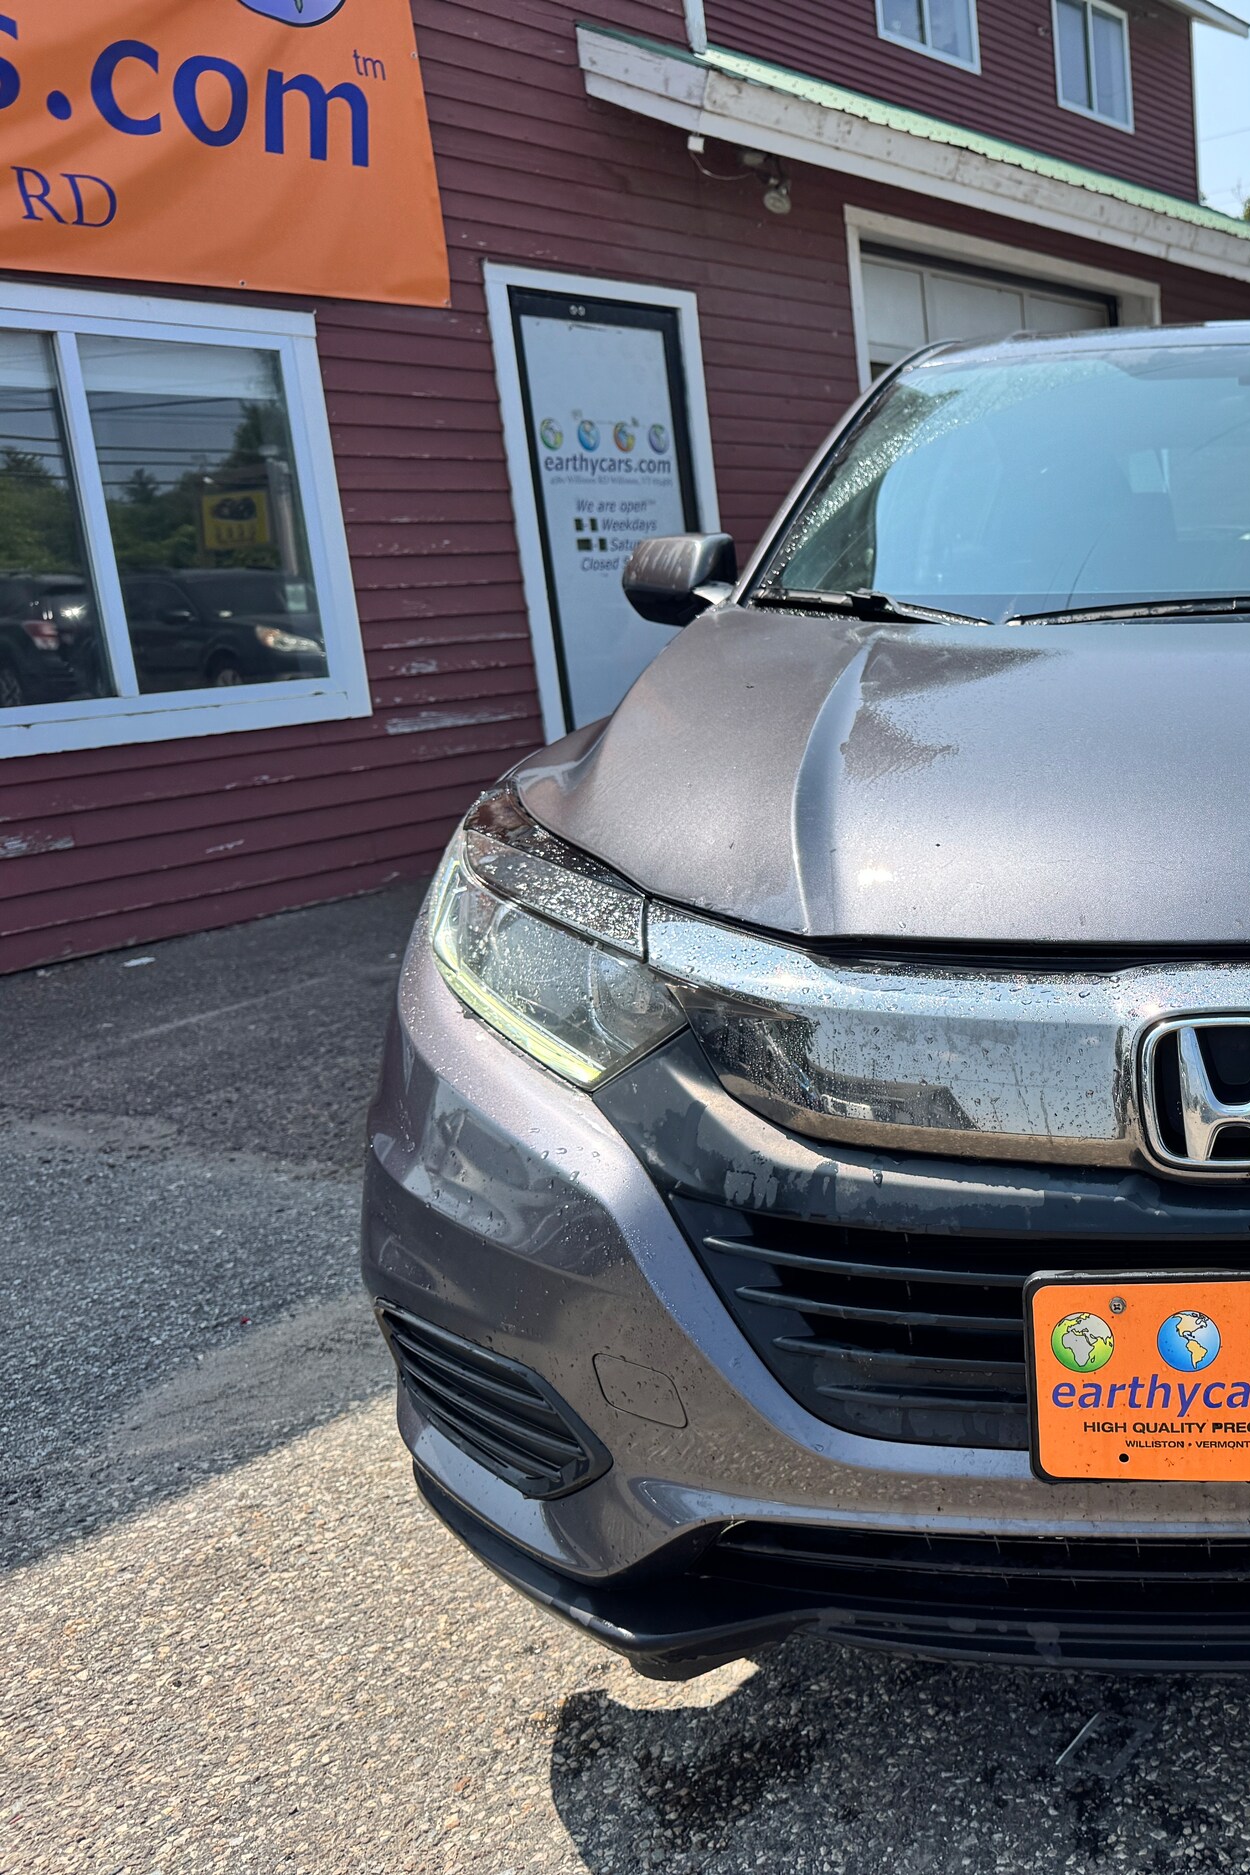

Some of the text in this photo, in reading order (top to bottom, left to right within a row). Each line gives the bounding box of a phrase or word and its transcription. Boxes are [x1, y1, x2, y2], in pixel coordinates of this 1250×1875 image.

[353, 49, 386, 81] tm
[10, 165, 118, 228] RD
[544, 453, 671, 476] earthycars.com
[577, 500, 647, 515] We are open
[602, 518, 657, 533] Weekdays
[609, 538, 641, 552] Satu
[582, 557, 619, 571] Closed
[1083, 1421, 1127, 1433] HIGH
[1132, 1422, 1206, 1434] QUALITY
[1125, 1440, 1185, 1448] WILLISTON
[1195, 1440, 1250, 1449] VERMONT
